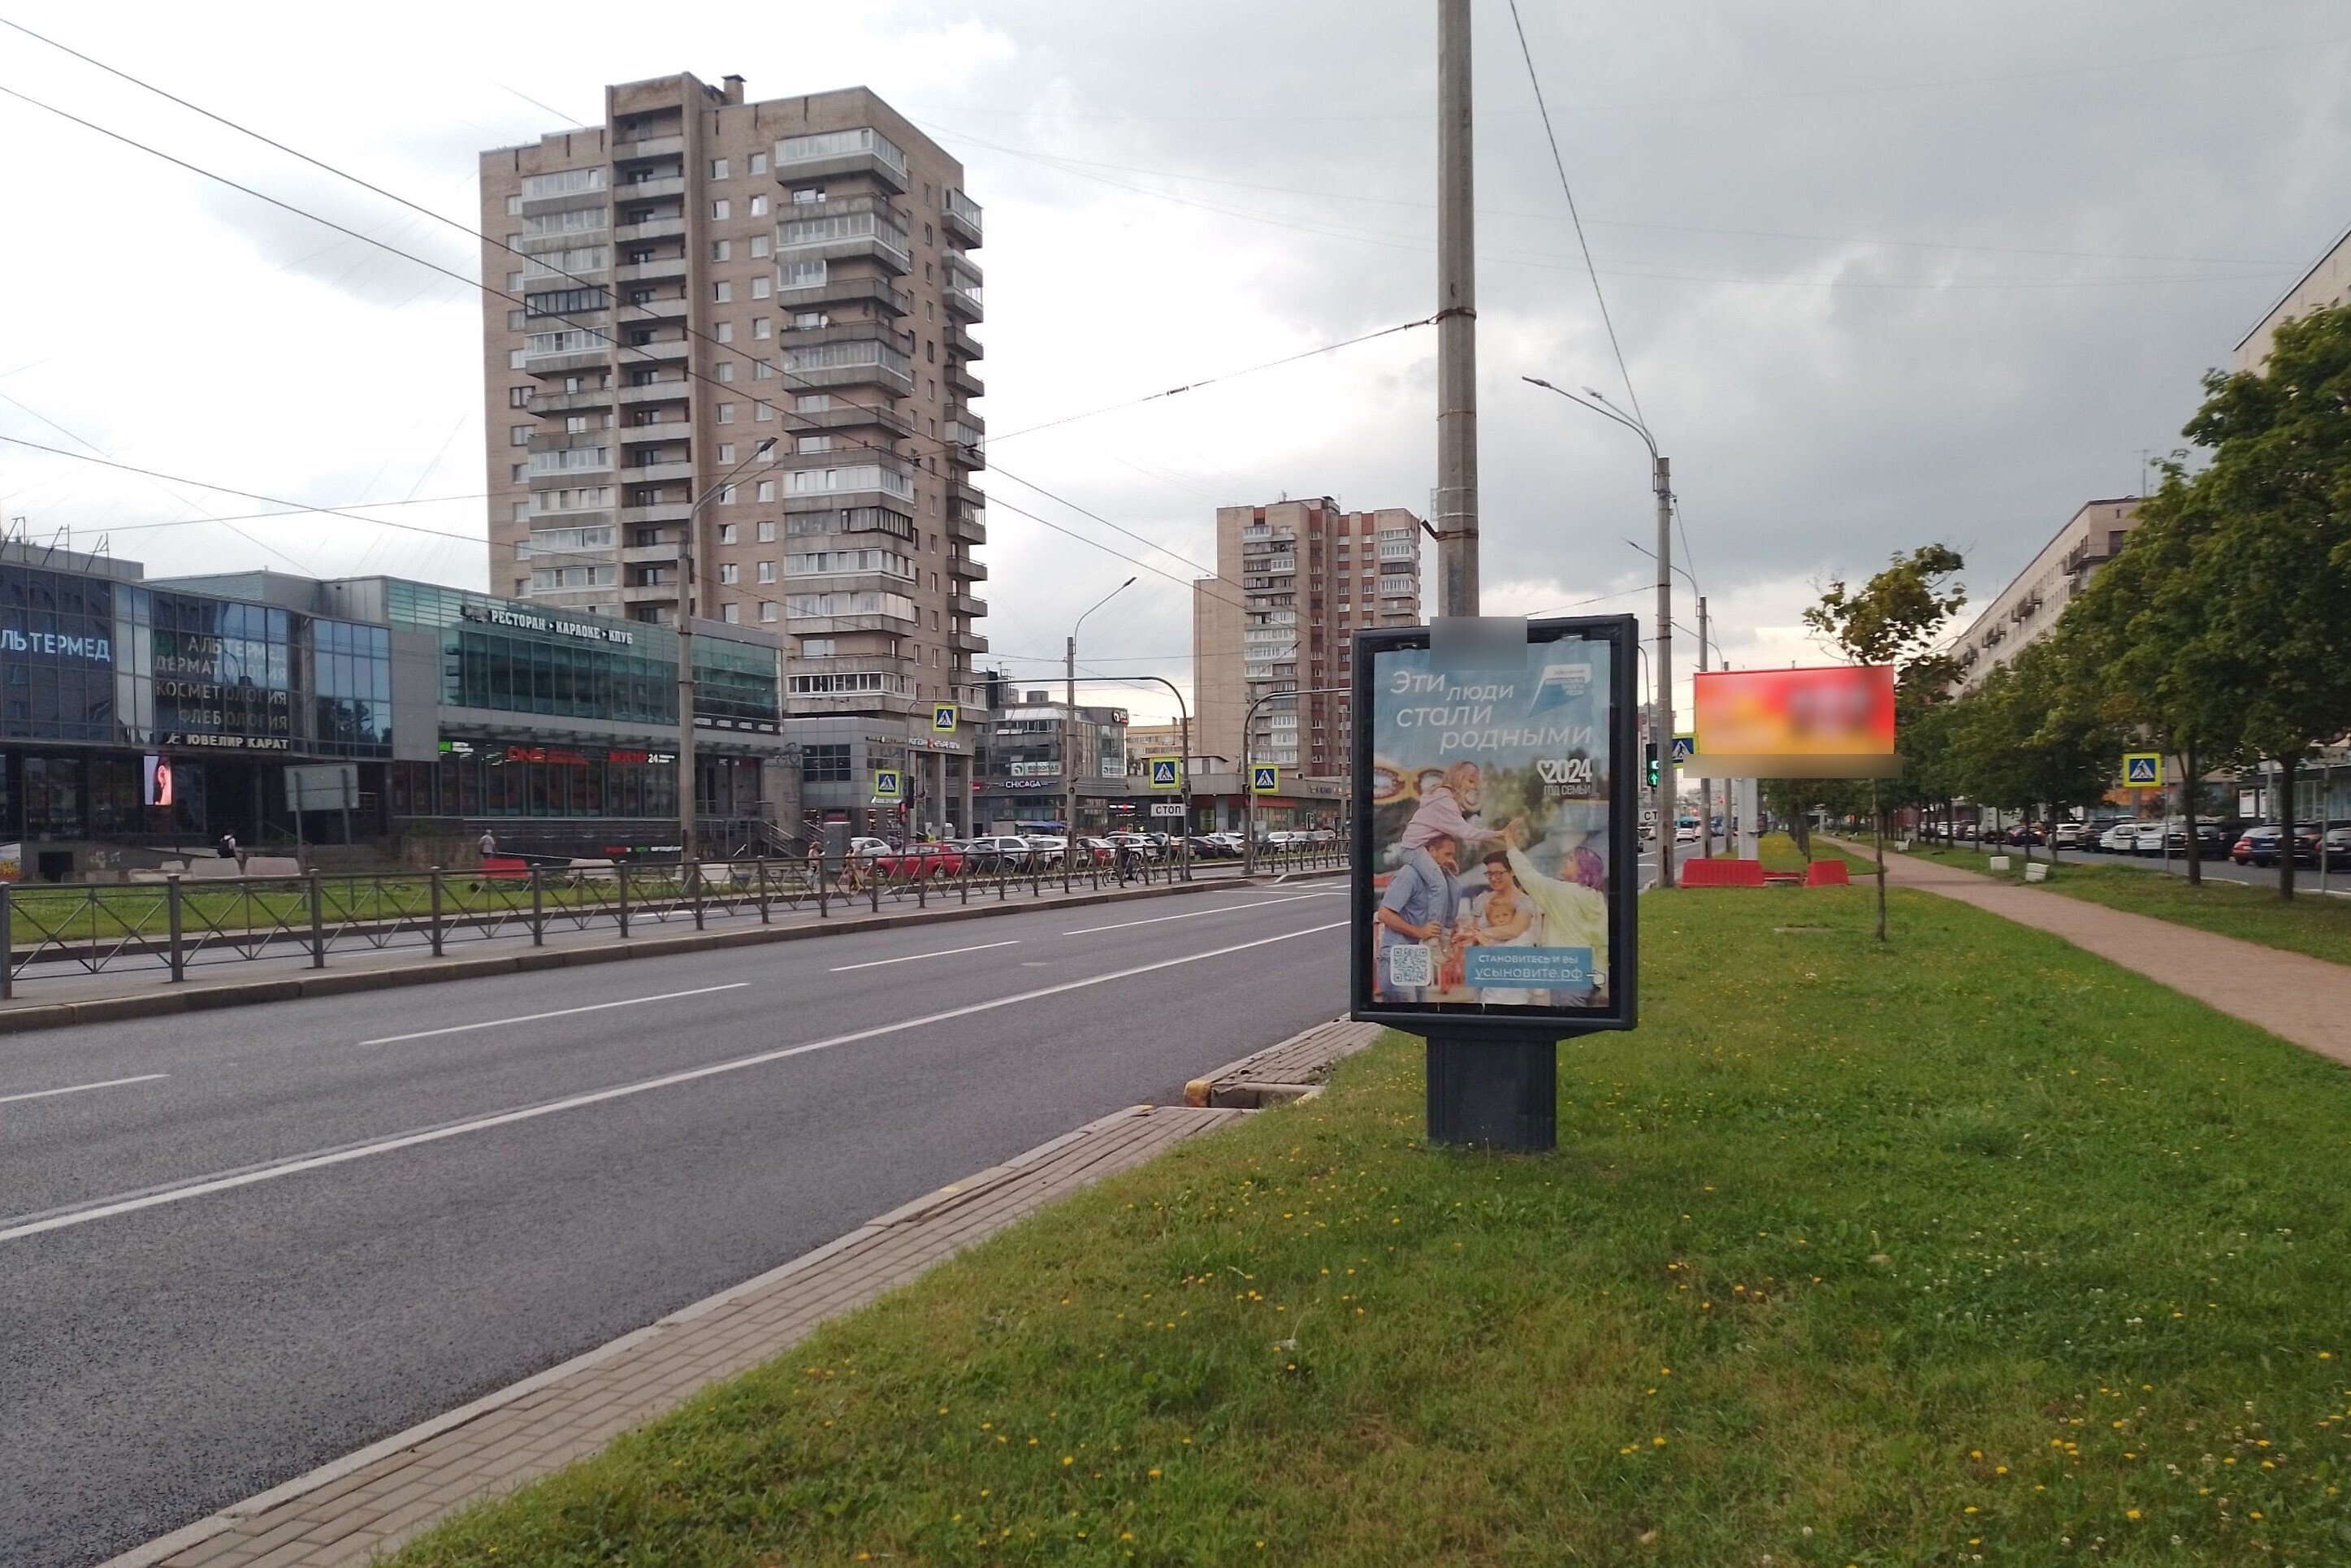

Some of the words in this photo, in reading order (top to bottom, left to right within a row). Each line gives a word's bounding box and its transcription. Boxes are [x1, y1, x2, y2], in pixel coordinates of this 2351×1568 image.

[491, 609, 546, 631] РЕСТОРАН
[556, 621, 600, 639] КАРАОКЕ
[608, 630, 633, 644] КЛУБ
[0, 630, 110, 662] ЛЬТЕРМЕД
[156, 682, 287, 705] КОСМЕТОЛОГИЯ
[1391, 671, 1445, 694] Эти
[1446, 685, 1514, 702] люди
[1396, 705, 1493, 727] стали
[187, 734, 243, 747] ЮВЕЛИР
[246, 738, 288, 749] КАРАТ
[1440, 726, 1592, 755] родными
[648, 754, 658, 764] 24
[1537, 759, 1592, 783] 2024
[1544, 785, 1560, 795] ГОД
[1561, 785, 1591, 795] СЕМЬИ
[1156, 806, 1181, 815] СТОП
[1644, 811, 1658, 820] СТ
[1479, 955, 1550, 964] СТАНОВИТЕСЬ
[1562, 955, 1578, 964] ВЫ
[1474, 967, 1583, 981] усыновите.рф
